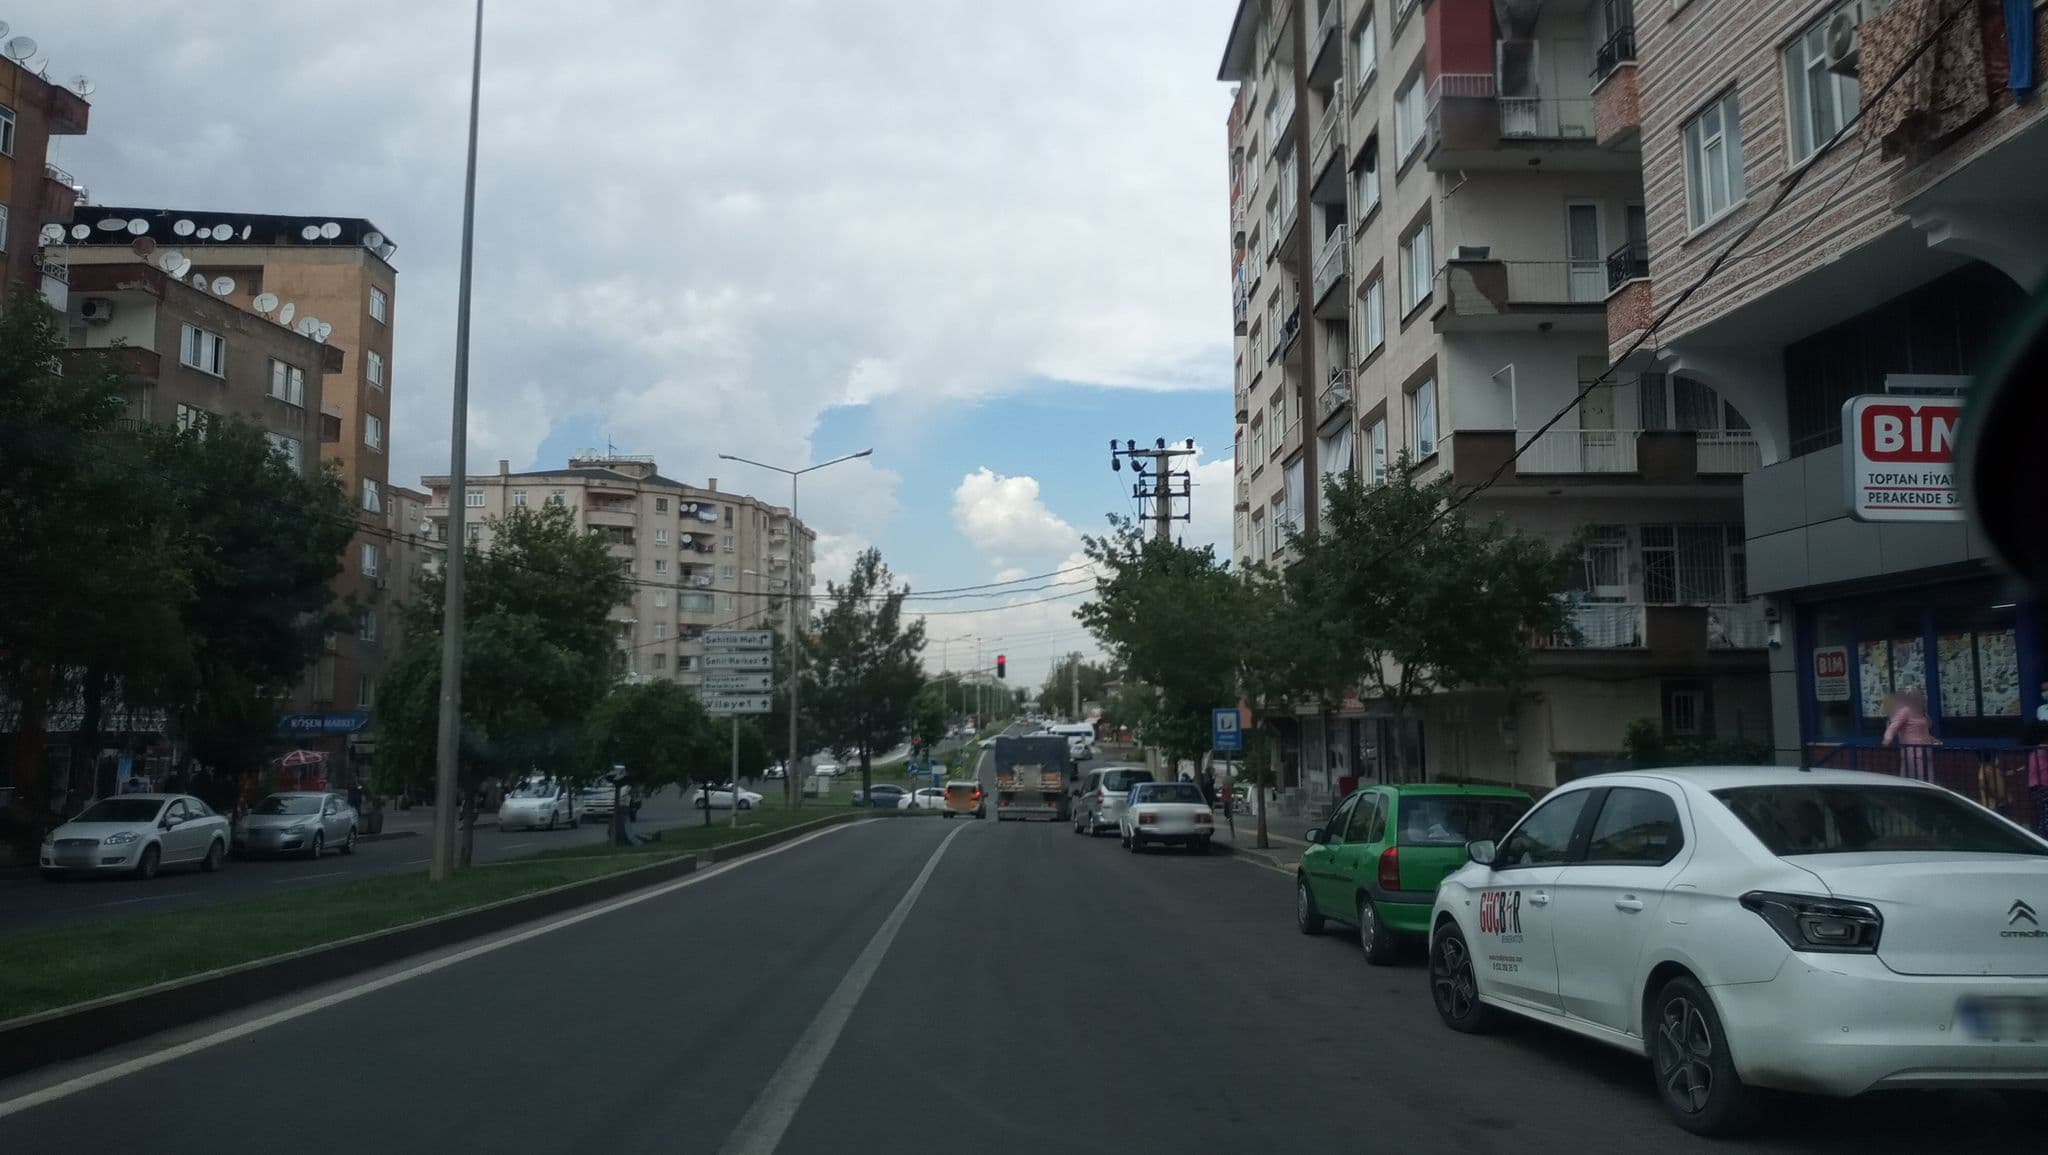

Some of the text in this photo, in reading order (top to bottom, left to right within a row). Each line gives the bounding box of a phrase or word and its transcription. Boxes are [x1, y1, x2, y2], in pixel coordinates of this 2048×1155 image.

[1868, 473, 1918, 485] TOPTAN
[1868, 492, 1942, 504] PERAKENDE
[706, 699, 751, 709] Vilayet
